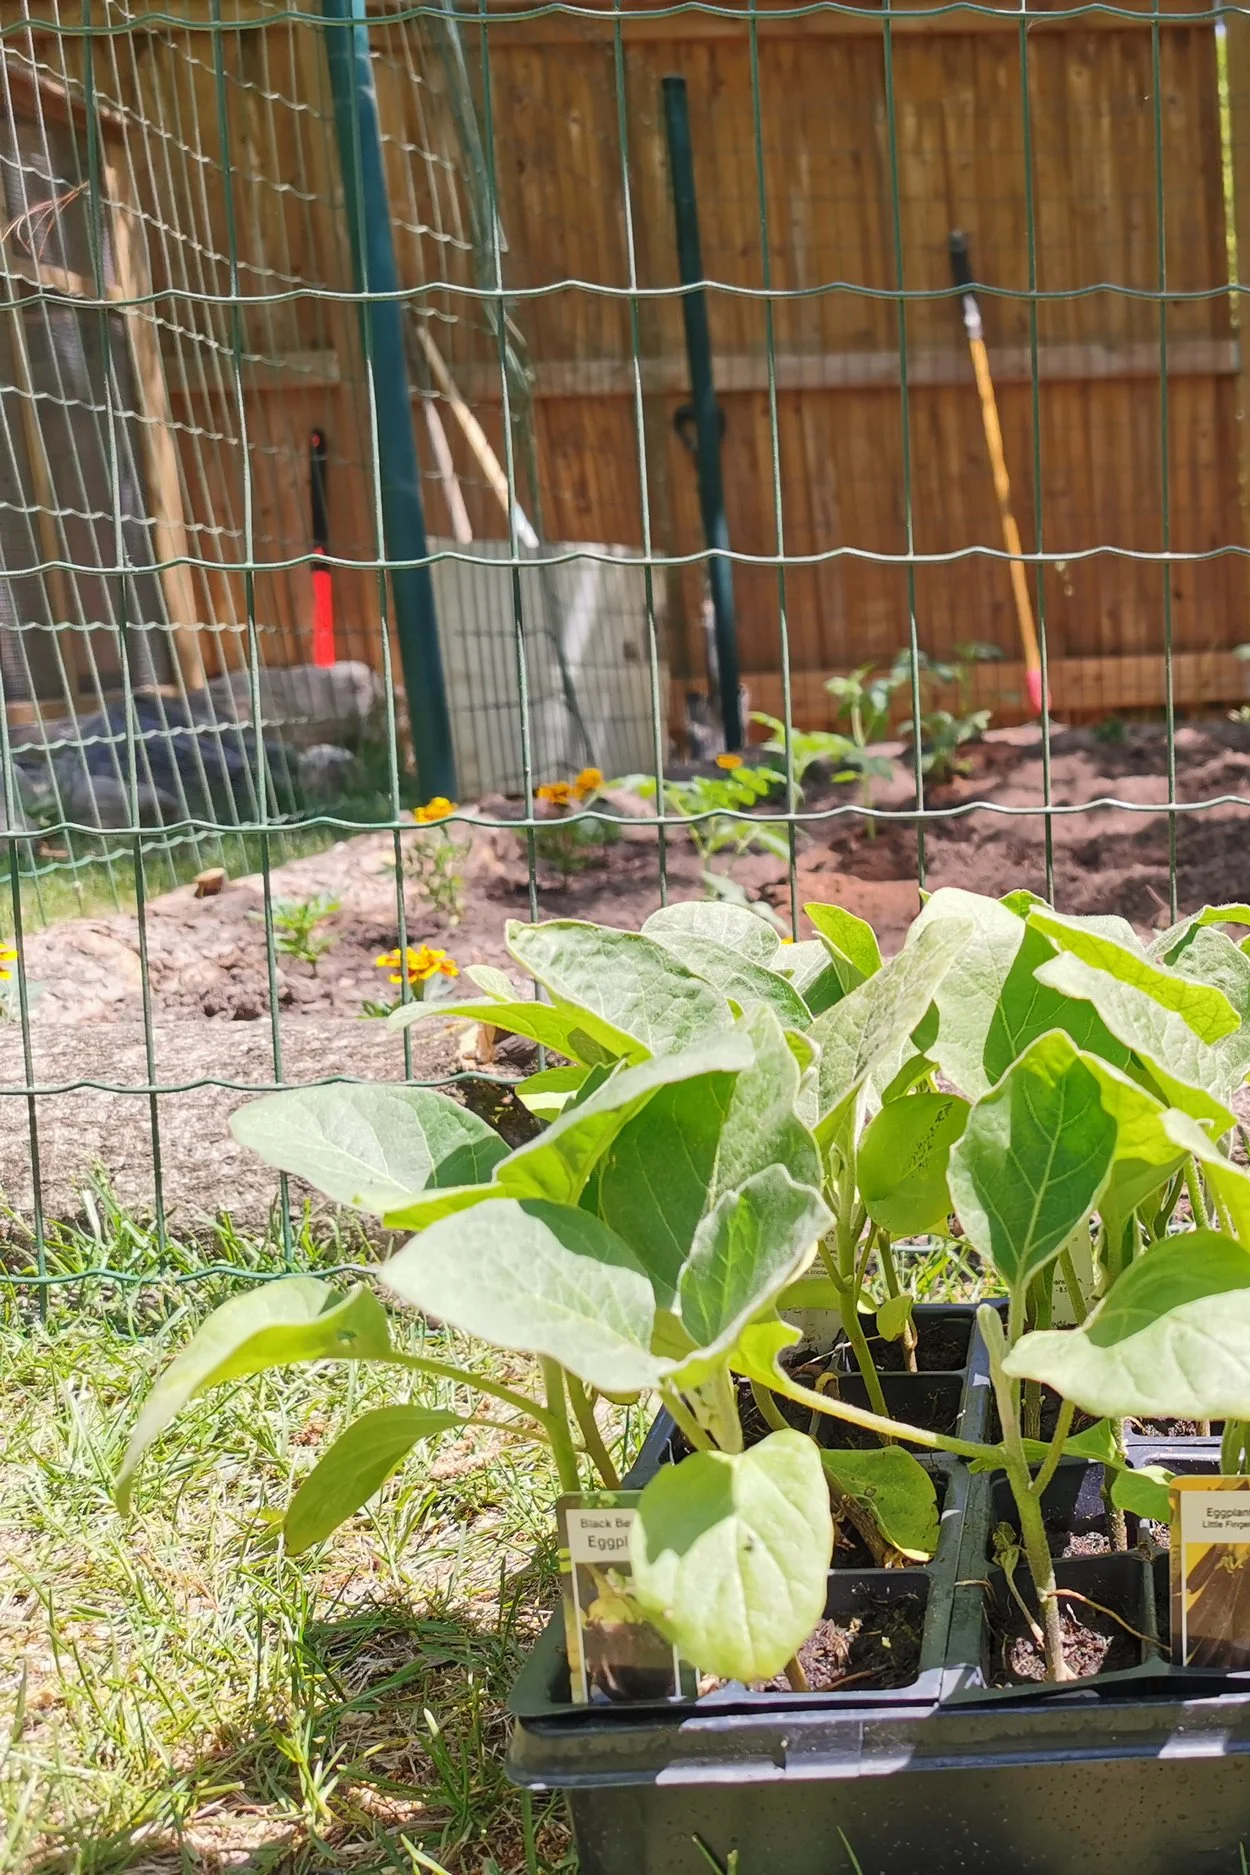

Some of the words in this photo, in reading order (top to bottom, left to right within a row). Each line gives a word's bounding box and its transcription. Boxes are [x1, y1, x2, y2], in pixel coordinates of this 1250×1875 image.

[580, 1517, 612, 1529] Black
[1202, 1520, 1223, 1529] Little
[588, 1535, 628, 1551] Eggpl
